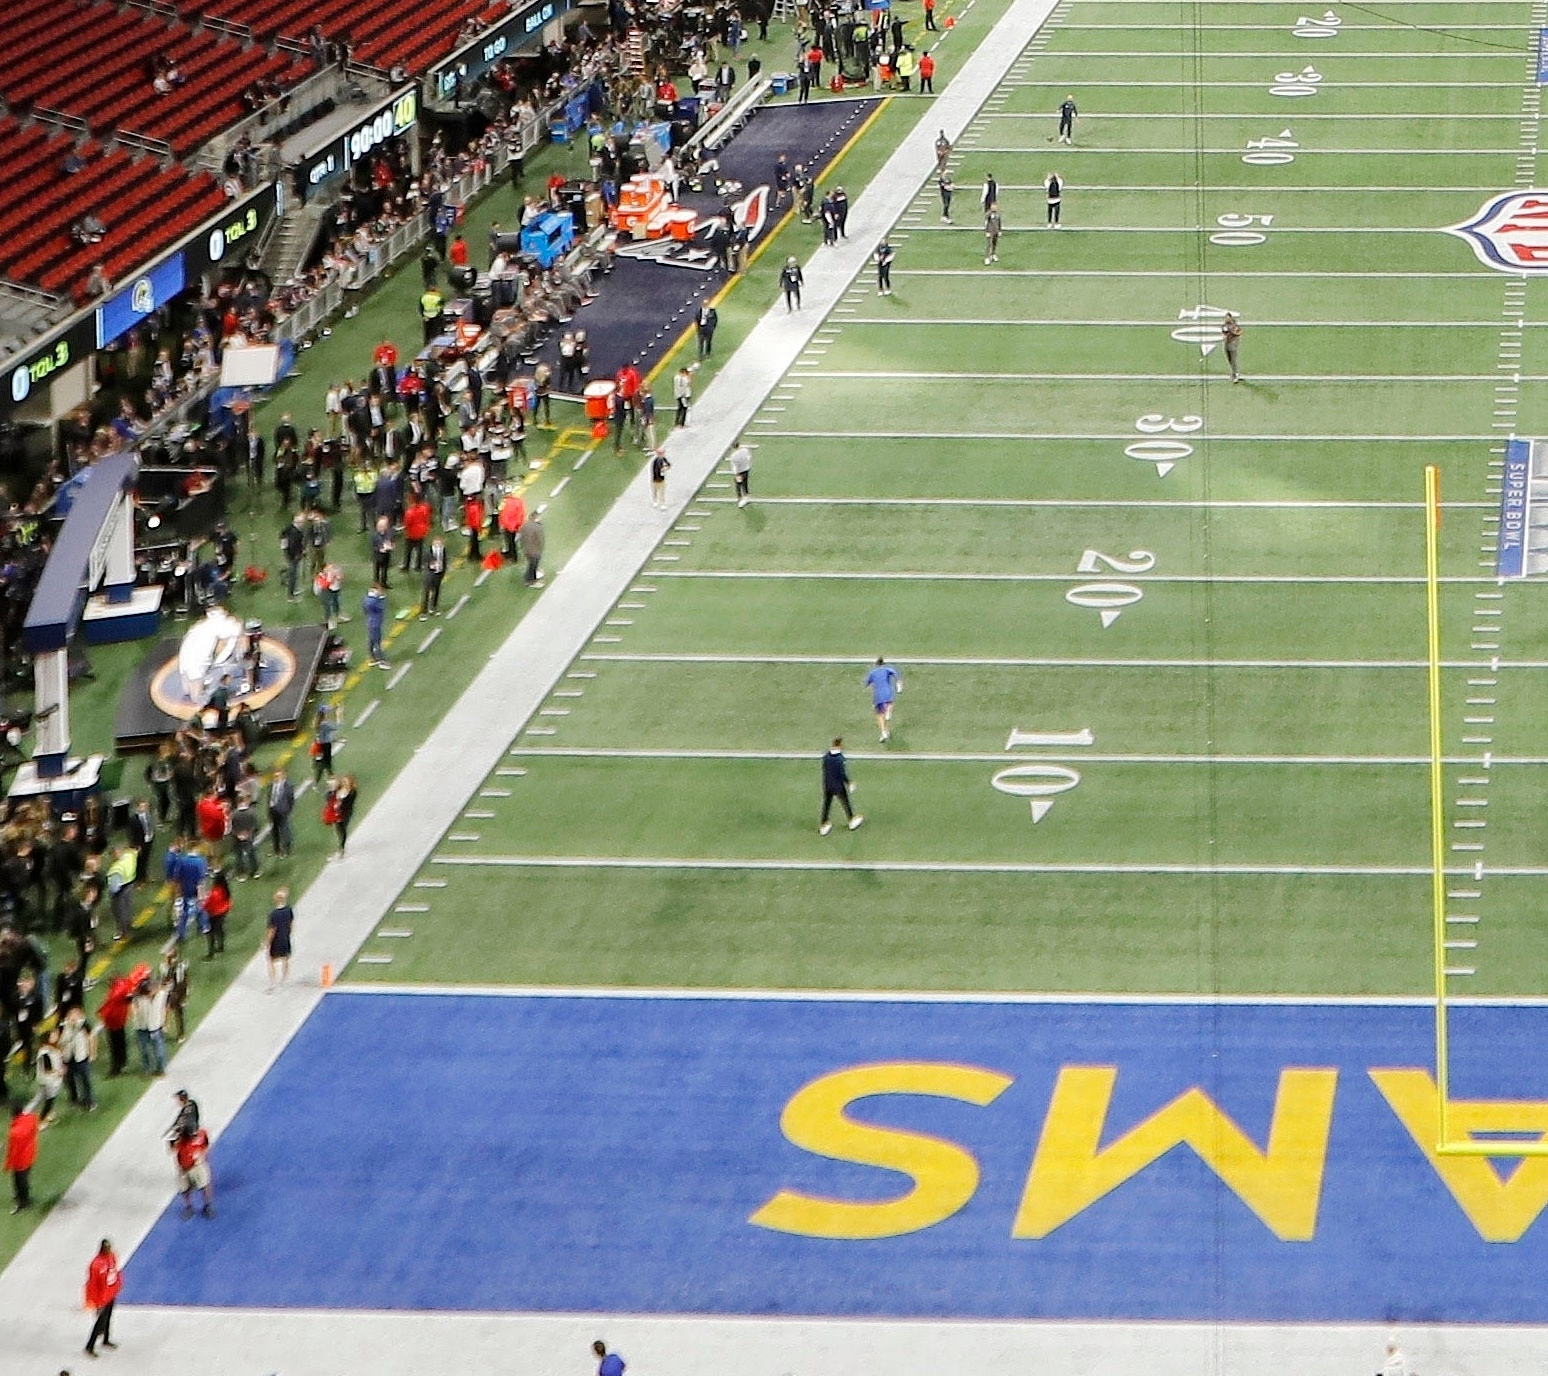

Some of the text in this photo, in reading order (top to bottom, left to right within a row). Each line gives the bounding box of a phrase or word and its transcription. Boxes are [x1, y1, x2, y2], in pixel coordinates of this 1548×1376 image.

[1292, 16, 1342, 38] 20
[1269, 71, 1323, 97] 30
[394, 92, 416, 130] 40
[350, 108, 394, 161] 90:00
[1241, 136, 1300, 165] 40
[209, 227, 226, 262] 0
[245, 208, 258, 233] 3
[1209, 212, 1274, 245] 50
[1170, 305, 1239, 344] 40
[11, 365, 30, 403] 0
[54, 340, 70, 369] 3
[1124, 414, 1203, 460] 30
[1504, 463, 1526, 551] SUPER BOWL
[1065, 549, 1156, 608] 20
[991, 727, 1096, 796] 10
